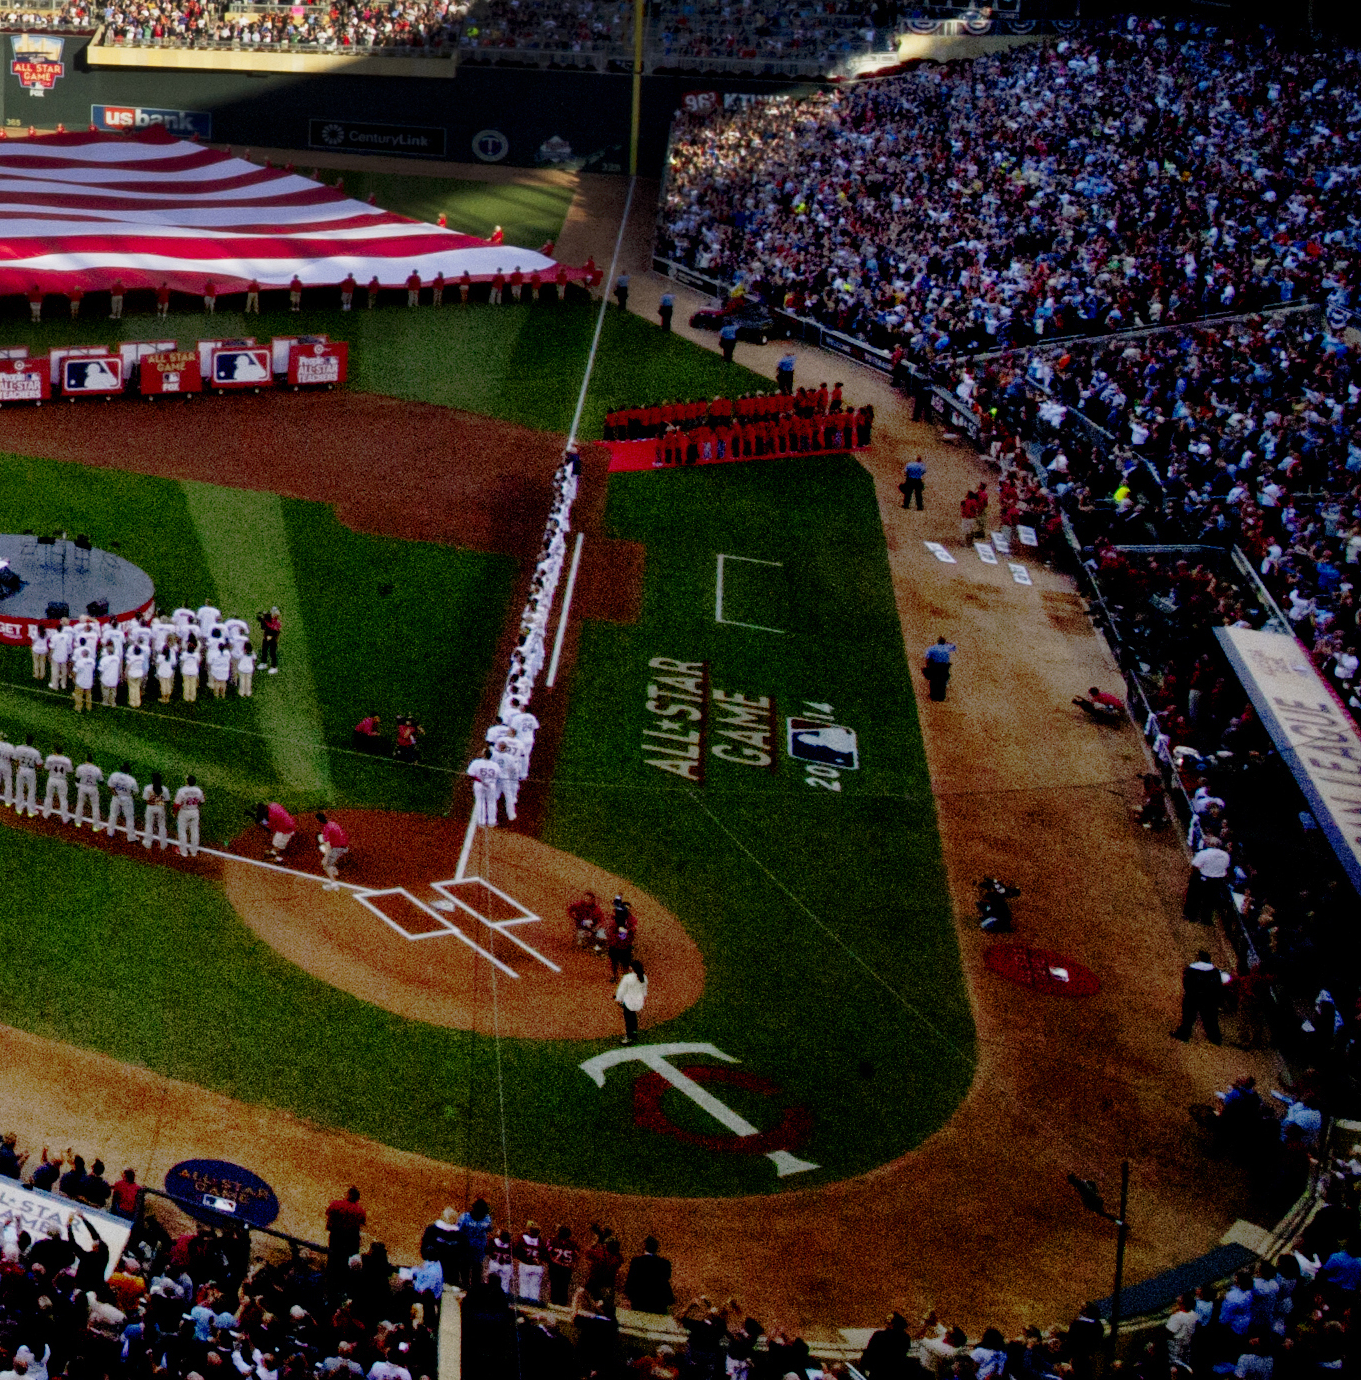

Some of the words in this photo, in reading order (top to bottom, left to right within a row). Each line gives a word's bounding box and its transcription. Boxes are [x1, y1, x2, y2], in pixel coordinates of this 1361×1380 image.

[14, 63, 33, 73] ALL
[36, 63, 61, 73] STAR
[24, 72, 51, 81] GAME
[349, 130, 430, 148] CenturyLink
[148, 353, 167, 363] ALL
[169, 352, 196, 362] STAR
[157, 362, 186, 372] GAME
[645, 657, 703, 721] STAR
[712, 688, 772, 766] GAME
[641, 729, 701, 781] ALL
[805, 763, 842, 792] 20
[554, 1248, 573, 1263] 75
